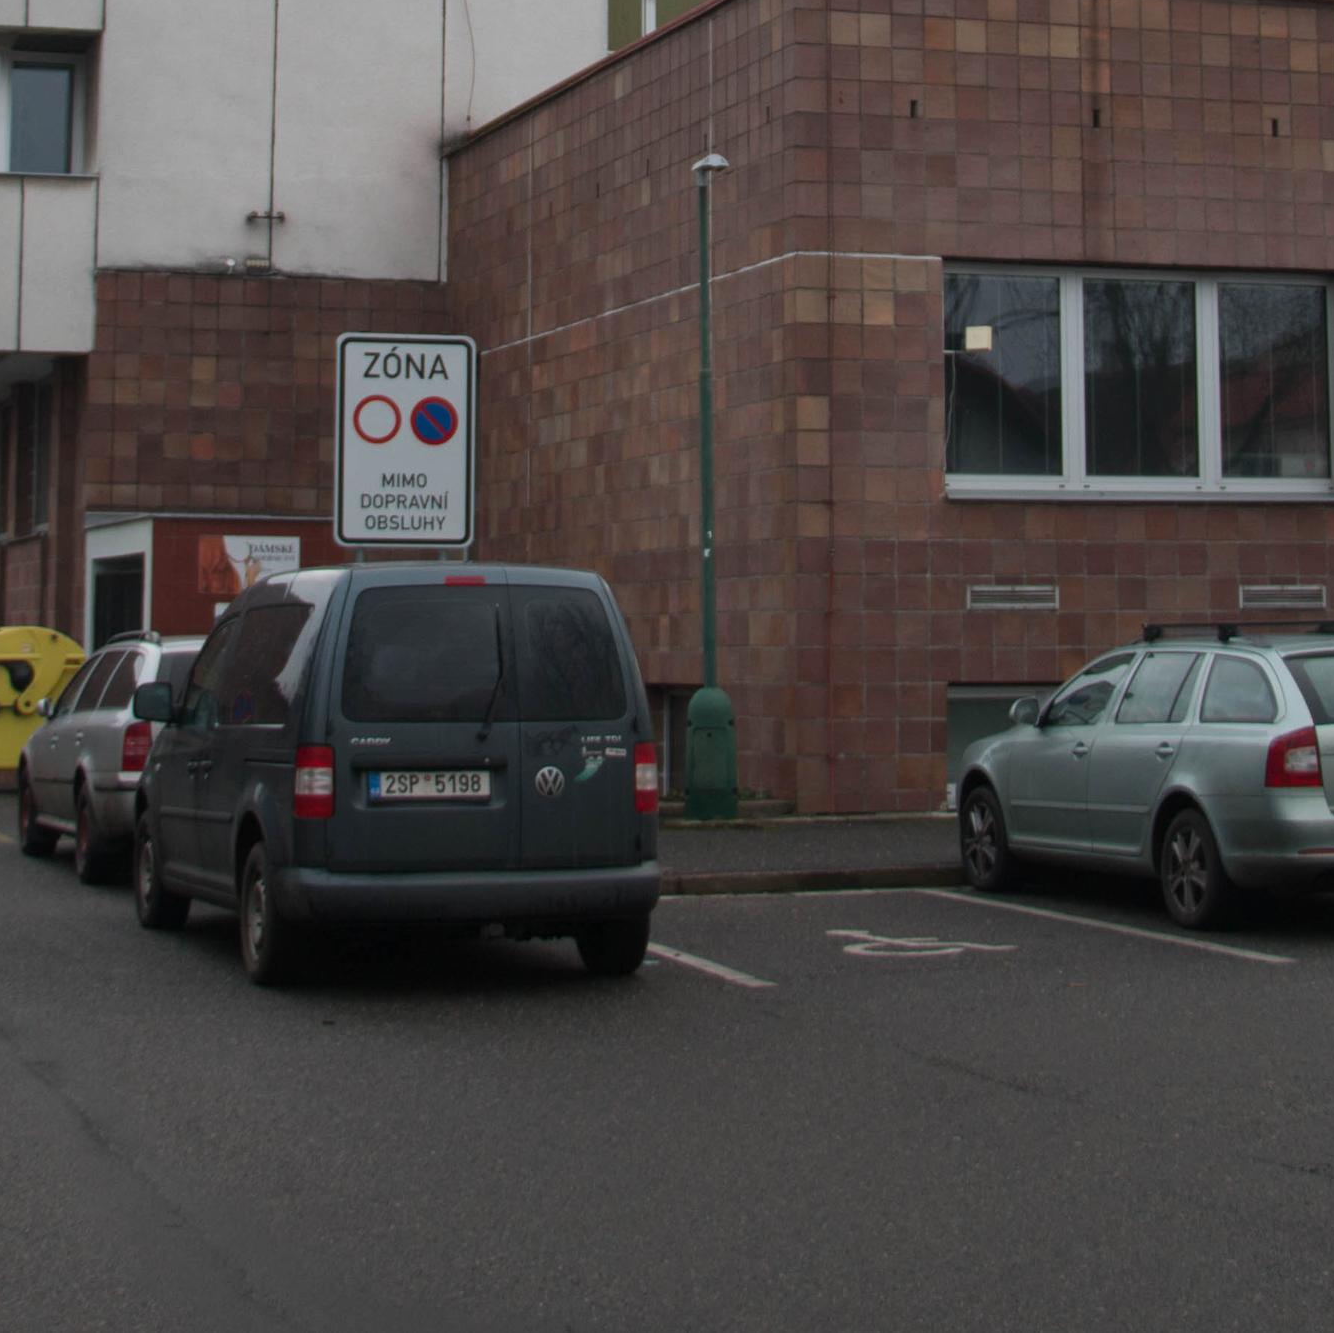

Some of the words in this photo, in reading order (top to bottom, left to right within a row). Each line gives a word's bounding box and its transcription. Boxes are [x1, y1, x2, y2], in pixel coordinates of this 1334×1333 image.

[363, 346, 449, 380] ZÓNA
[381, 472, 428, 488] MIMO
[360, 491, 449, 510] DOPRAVNÍ
[364, 515, 446, 531] OBSLUHY
[385, 773, 420, 794] 2SP
[435, 772, 481, 793] 5198
